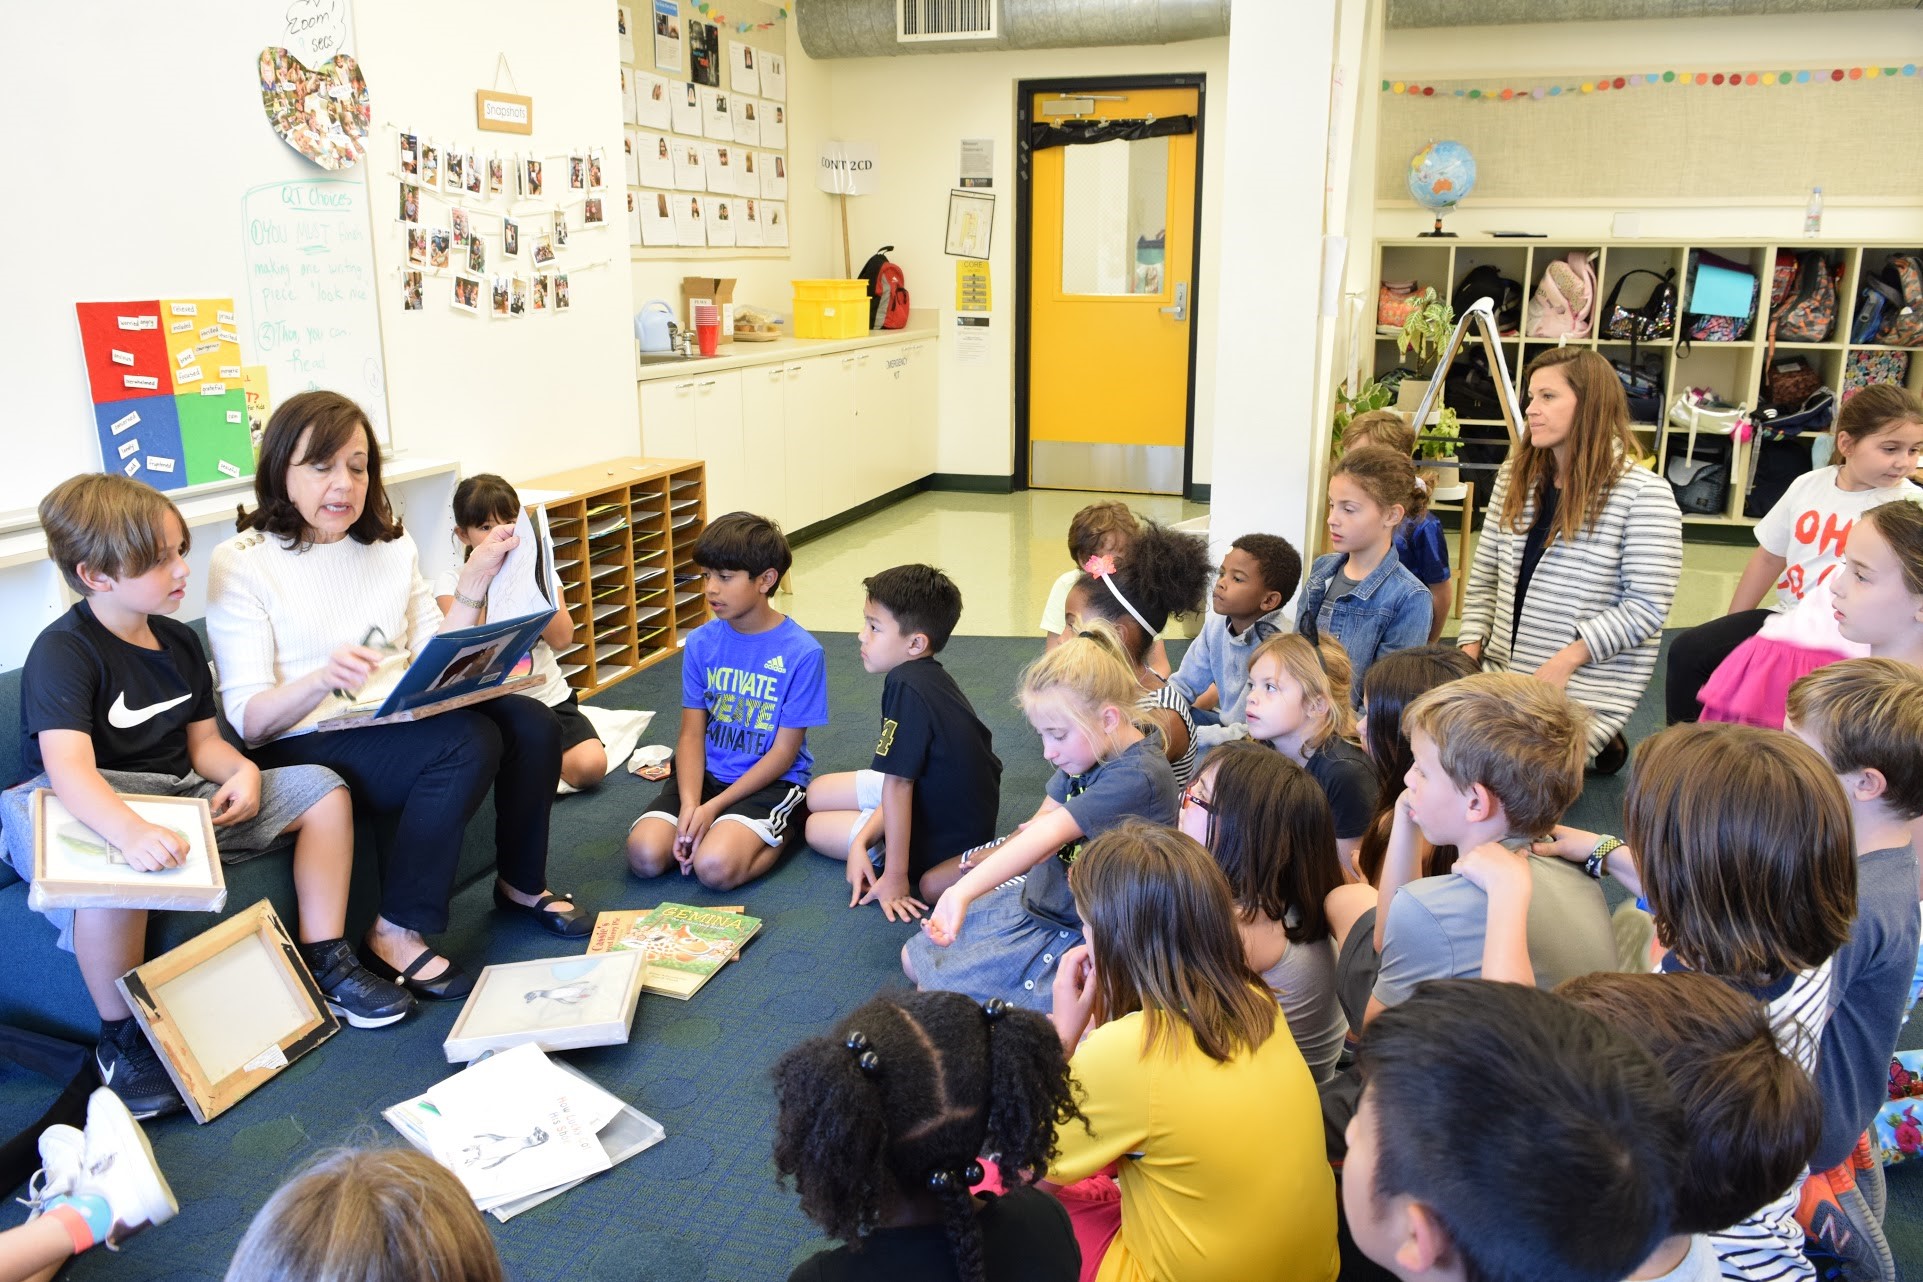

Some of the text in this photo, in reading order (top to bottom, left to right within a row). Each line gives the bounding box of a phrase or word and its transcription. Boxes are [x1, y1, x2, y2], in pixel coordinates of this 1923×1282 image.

[311, 35, 334, 52] secs
[486, 103, 526, 119] Snapshots
[850, 159, 873, 171] 2CD
[308, 187, 352, 207] Choices
[296, 221, 330, 243] MUST
[255, 257, 362, 285] making one writing
[262, 287, 296, 312] piece
[173, 304, 195, 313] relieved
[120, 319, 139, 327] worried
[202, 384, 224, 395] grateful
[1795, 510, 1853, 557] OH
[764, 663, 786, 674] adidas
[662, 907, 742, 929] GEMINA
[592, 922, 610, 951] Cassie's
[547, 1111, 561, 1126] His
